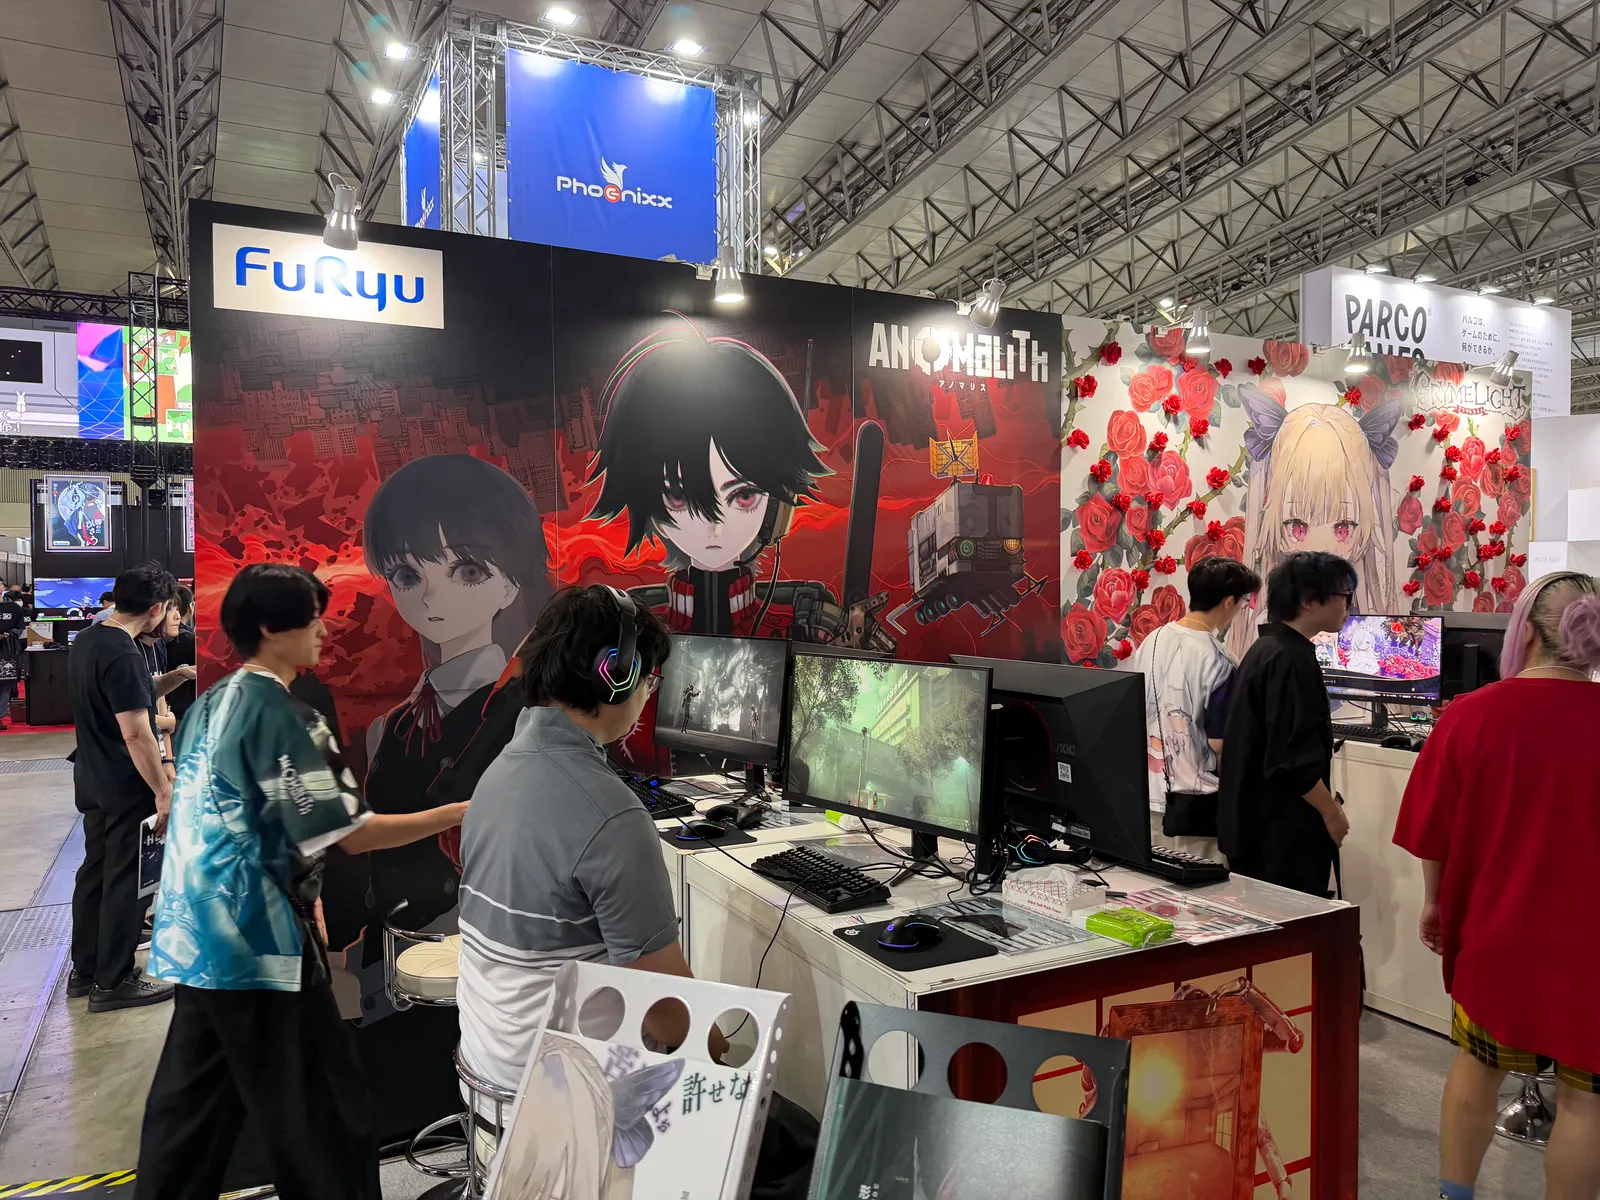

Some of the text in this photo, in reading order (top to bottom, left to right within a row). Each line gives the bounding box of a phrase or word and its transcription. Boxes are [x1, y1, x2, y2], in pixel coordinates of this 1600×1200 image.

[556, 175, 673, 210] Phoenixx
[235, 246, 425, 312] FuRyu
[1344, 294, 1427, 345] PARCO
[938, 380, 987, 392] アノマリス
